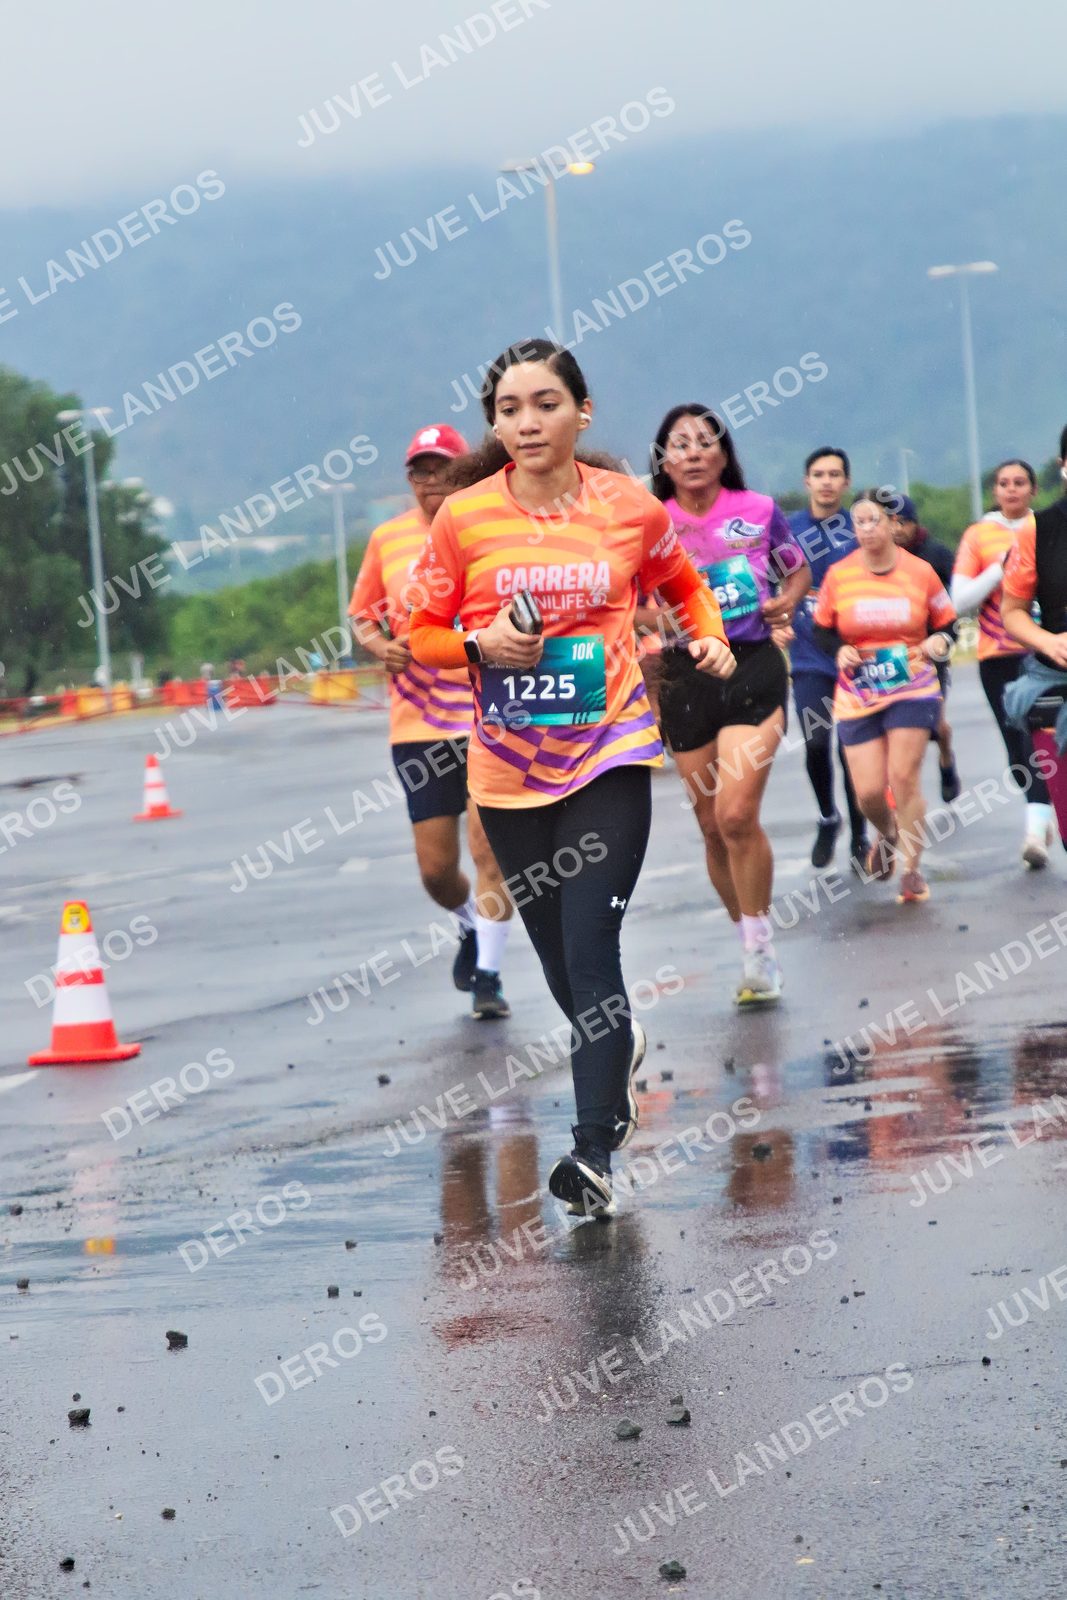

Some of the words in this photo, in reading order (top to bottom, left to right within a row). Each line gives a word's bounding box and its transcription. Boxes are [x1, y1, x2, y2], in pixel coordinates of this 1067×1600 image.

[496, 561, 610, 596] CARRERA
[500, 593, 585, 611] ONILIFE
[572, 642, 595, 661] 10K
[502, 673, 577, 701] 1225
